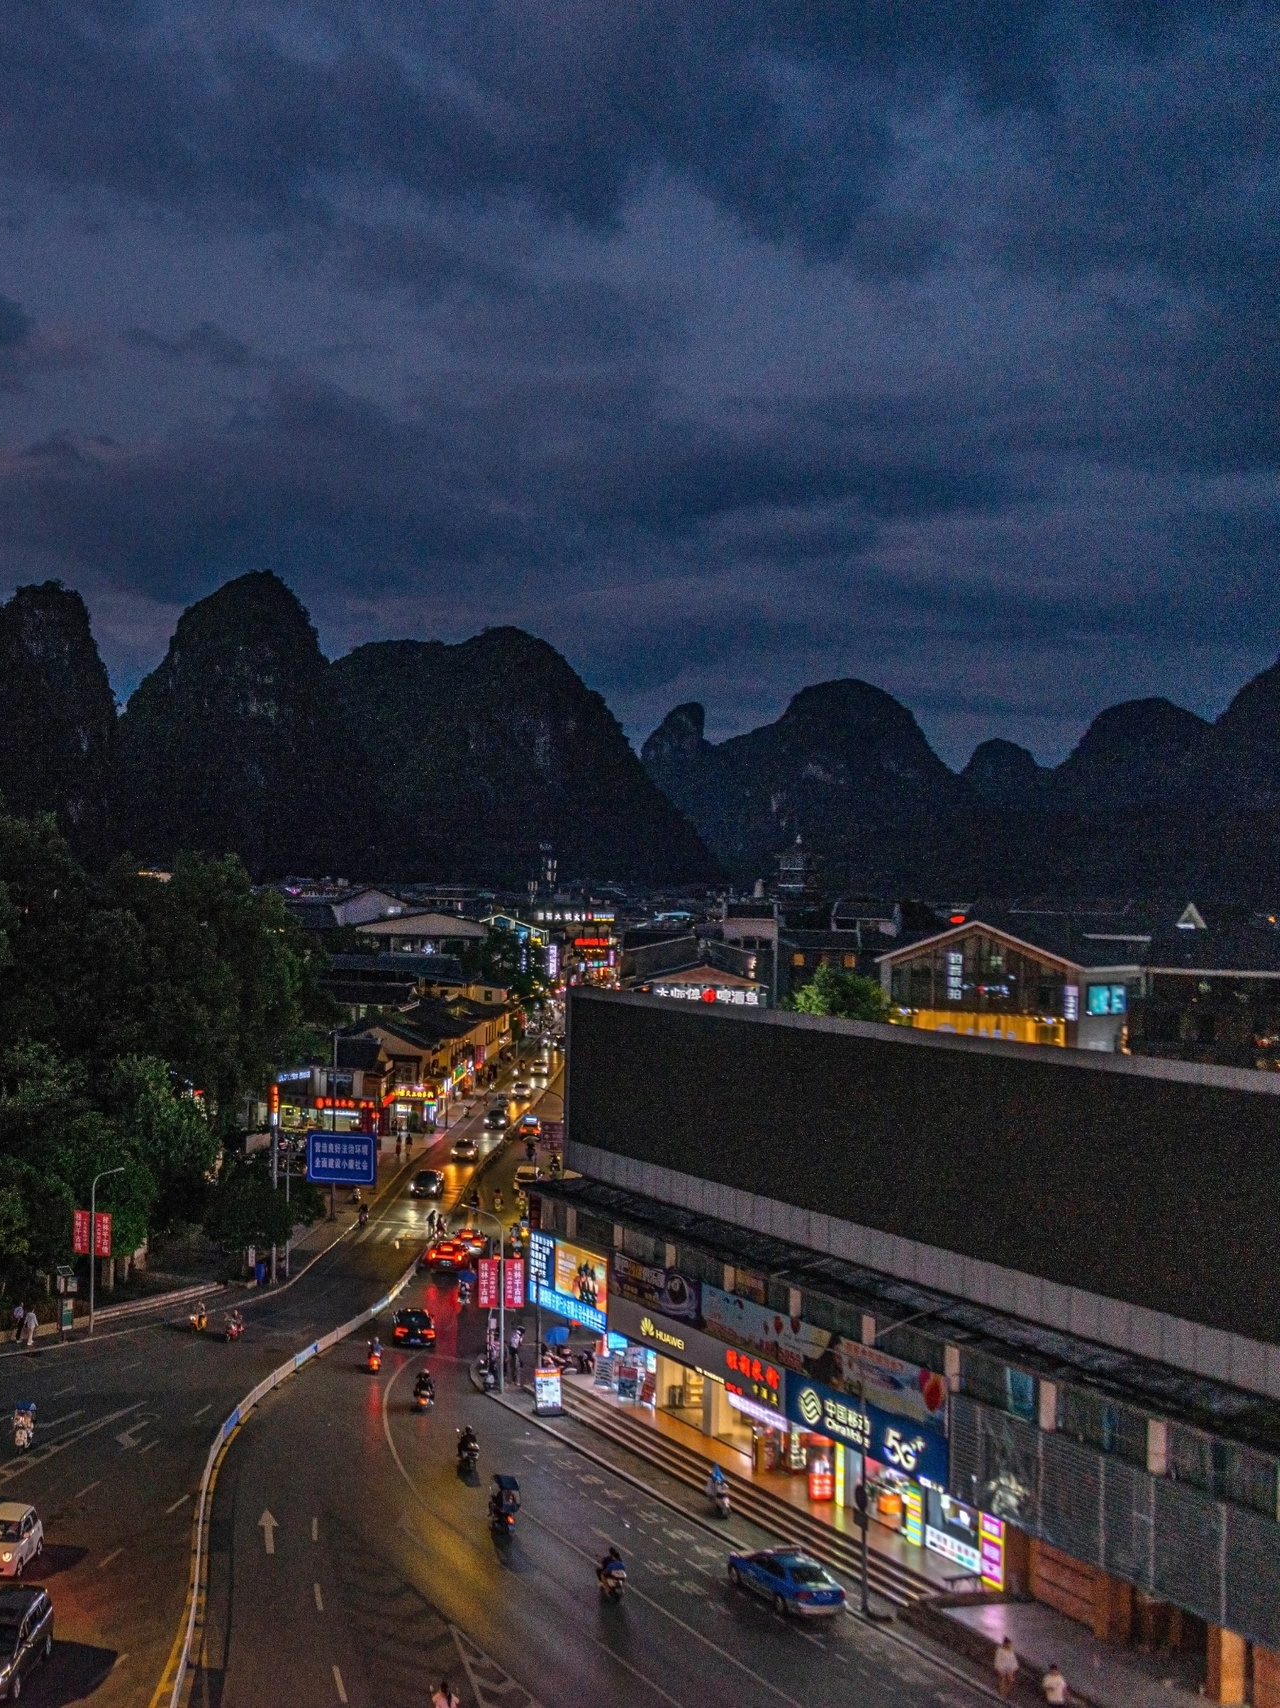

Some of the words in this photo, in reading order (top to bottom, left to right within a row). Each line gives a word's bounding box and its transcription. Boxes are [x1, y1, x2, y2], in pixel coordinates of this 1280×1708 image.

[716, 989, 759, 1005] 啤酒鱼
[314, 1156, 369, 1171] 全面建设小康社会
[480, 1262, 489, 1305] 桂林千古情
[513, 1262, 522, 1305] 桂林千古情
[655, 1329, 685, 1350] HUAWEI
[824, 1398, 871, 1436] 中国移动
